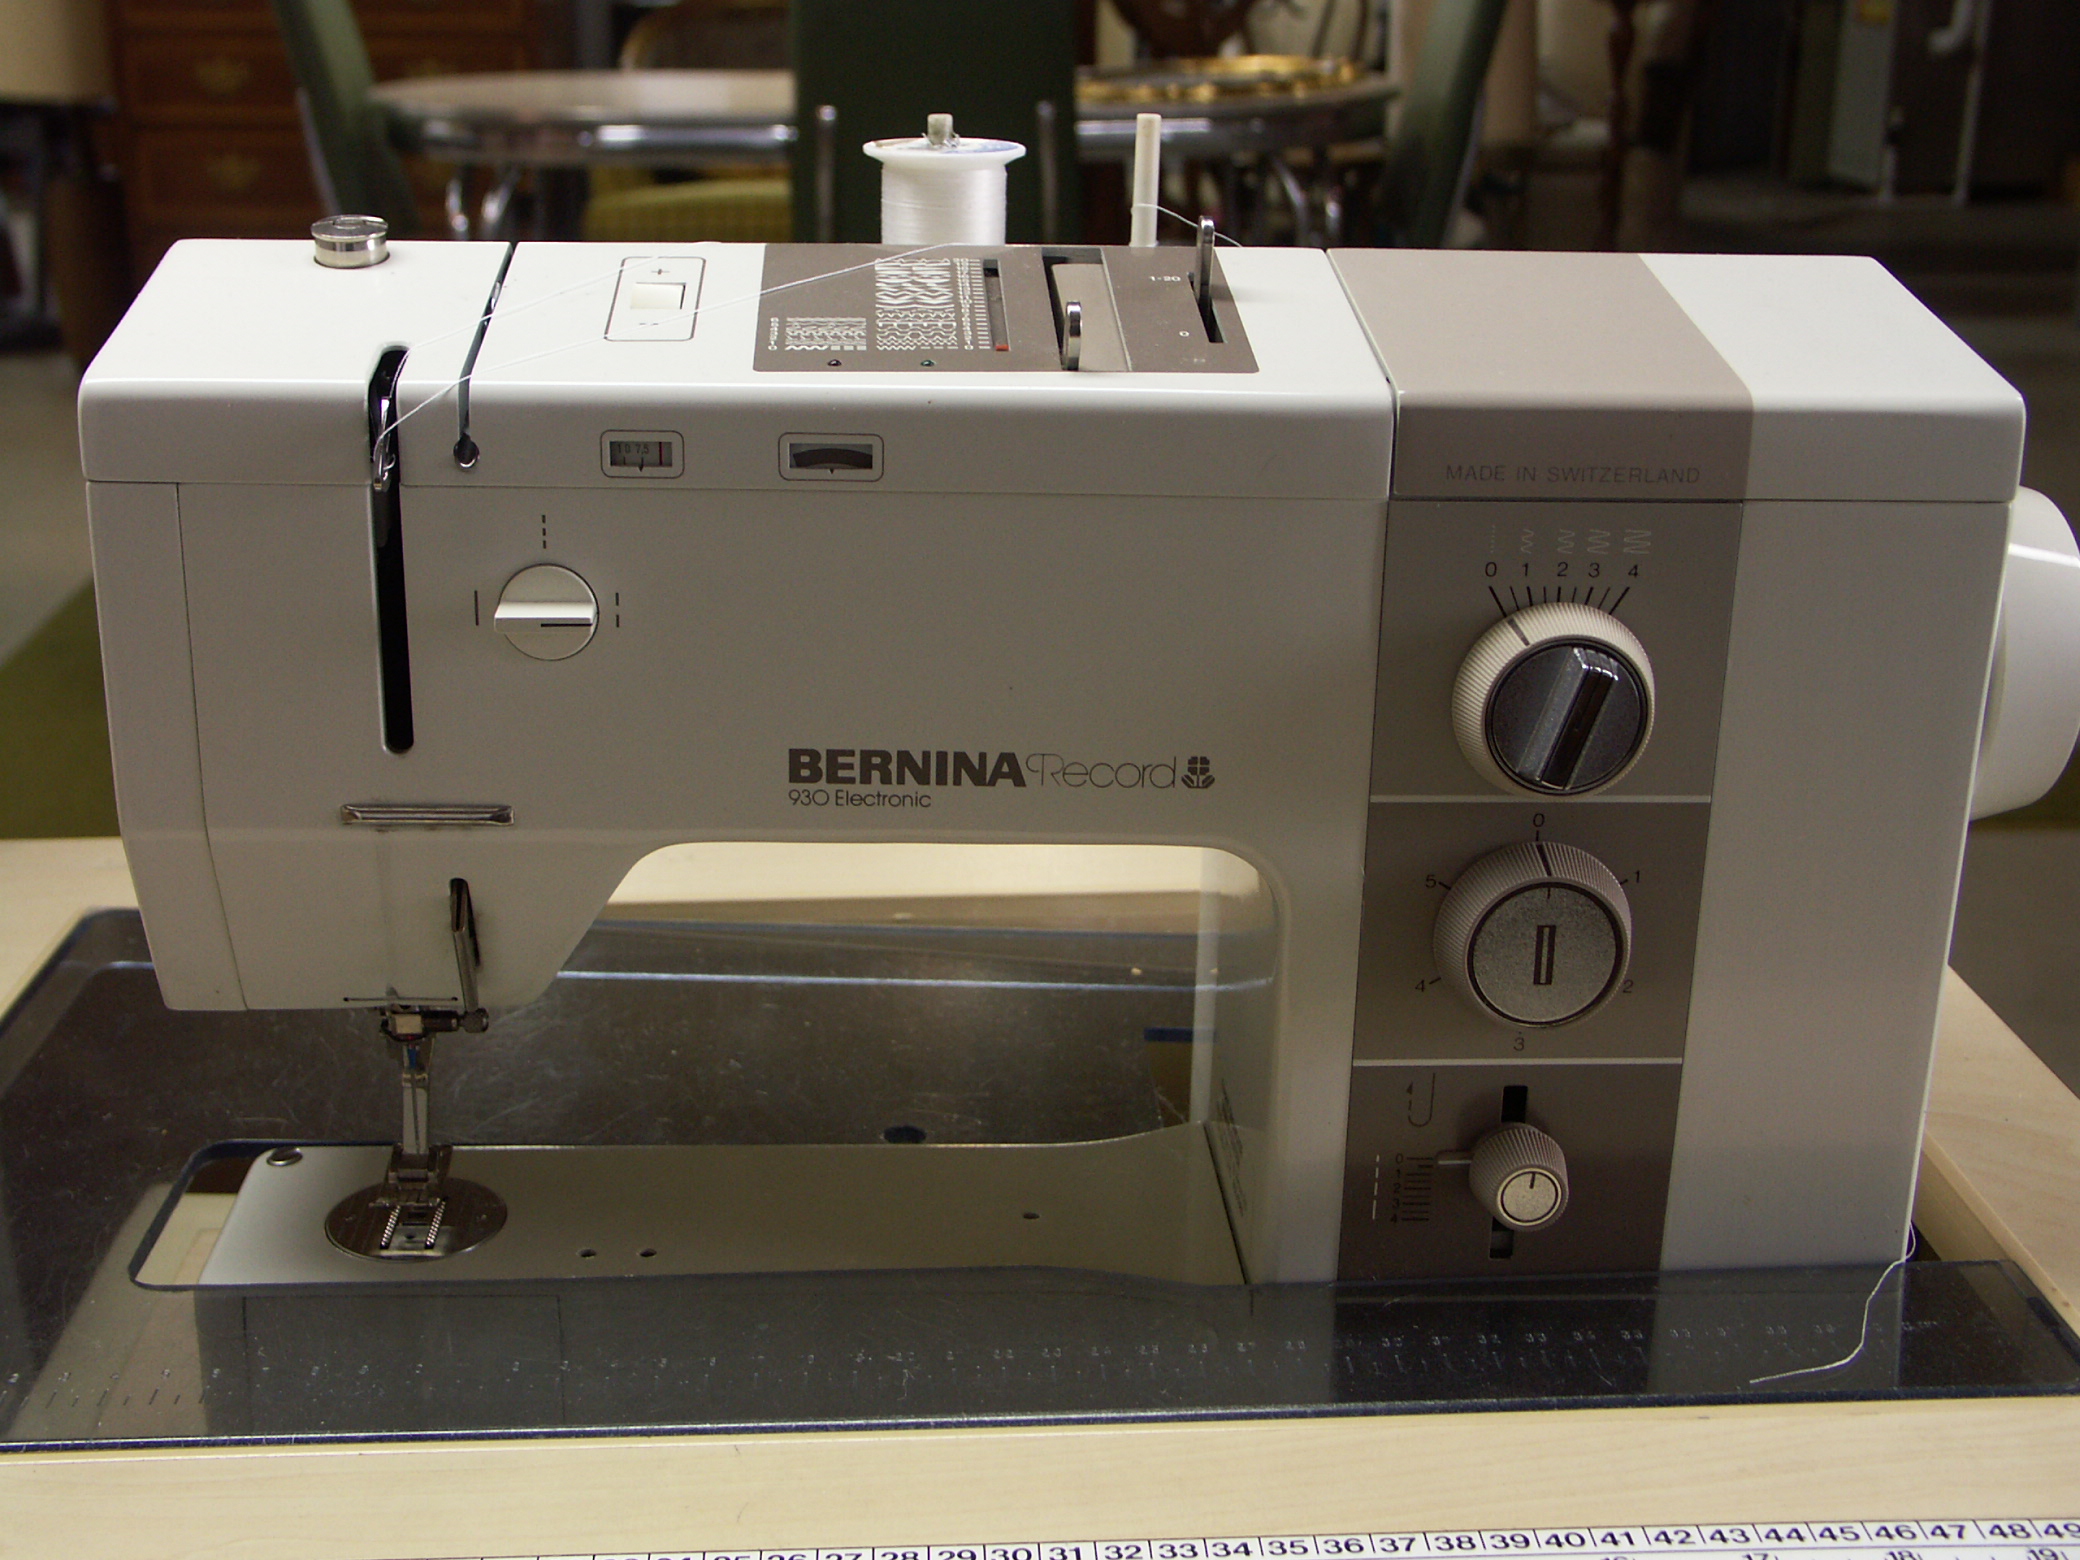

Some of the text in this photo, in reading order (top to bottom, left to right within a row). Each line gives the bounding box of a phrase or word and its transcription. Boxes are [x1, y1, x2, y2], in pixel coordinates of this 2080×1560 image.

[1446, 464, 1701, 484] MADE IN SWITZERLAND
[1484, 561, 1639, 578] 0 1 2 3 4
[787, 747, 1177, 789] BERNINA Record
[787, 789, 932, 808] 930 Electronic
[1532, 813, 1545, 828] 0
[1424, 874, 1437, 889] 5
[1634, 870, 1641, 884] 1
[1414, 979, 1426, 993] 4
[1622, 979, 1634, 994] 2
[1513, 1037, 1525, 1052] 3
[991, 1547, 1032, 1560] 30
[1048, 1546, 1082, 1560] 31
[1104, 1544, 1143, 1560] 32
[1158, 1543, 1199, 1559] 33
[1212, 1541, 1253, 1558] 34
[1268, 1539, 1309, 1556] 35
[1323, 1538, 1365, 1555] 36
[1379, 1536, 1417, 1553] 37
[1434, 1535, 1477, 1551] 38
[1489, 1533, 1530, 1550] 39
[1545, 1532, 1586, 1549] 40
[1600, 1531, 1636, 1547] 41
[1654, 1529, 1696, 1546] 42
[1709, 1528, 1751, 1545] 43
[1765, 1527, 1806, 1543] 44
[1819, 1525, 1861, 1541] 45
[1875, 1524, 1917, 1540] 46
[1930, 1524, 1967, 1540] 47
[1989, 1523, 2031, 1539] 48
[2043, 1522, 2080, 1539] 49
[2029, 1548, 2058, 1560] 19
